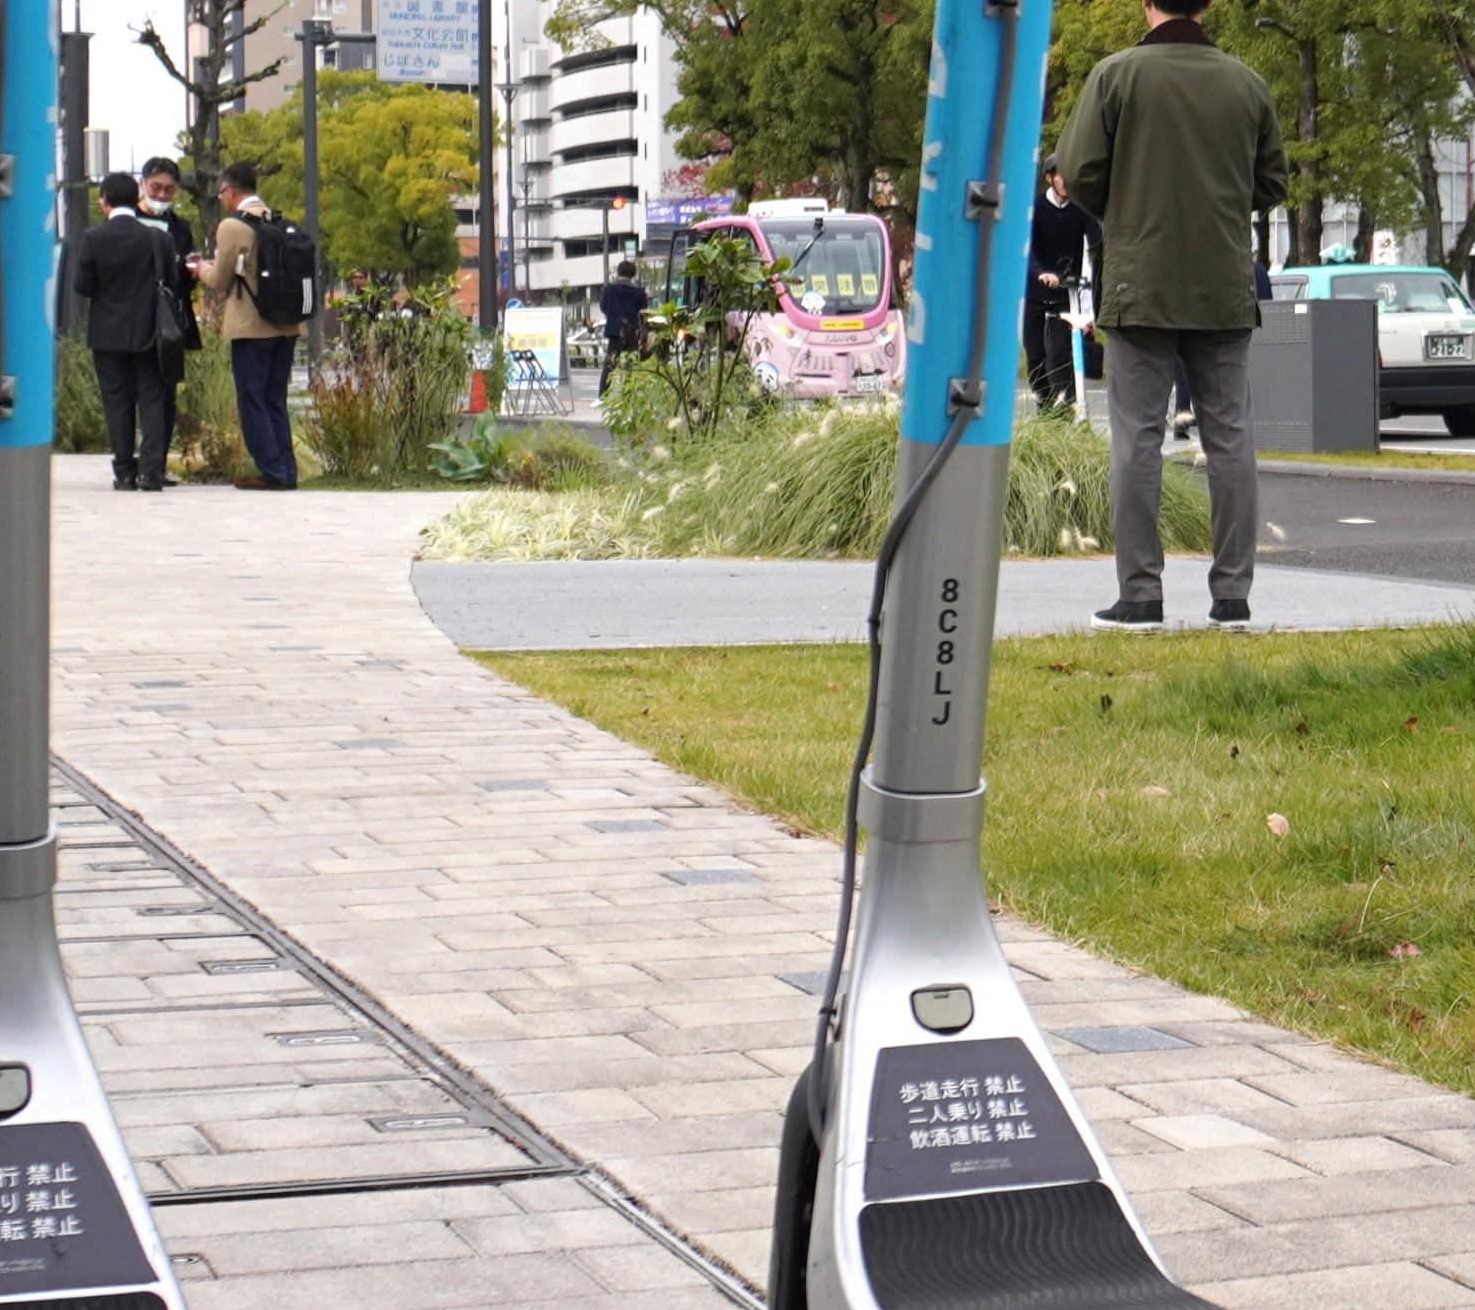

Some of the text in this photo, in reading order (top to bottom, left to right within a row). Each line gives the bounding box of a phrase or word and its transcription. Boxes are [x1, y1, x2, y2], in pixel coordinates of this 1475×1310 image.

[931, 578, 959, 727] 8C8LJ
[899, 1074, 1026, 1104] 歩道走行 禁止
[908, 1097, 1029, 1125] 二人乗り 禁止
[909, 1120, 1038, 1150] 飲酒運転 禁止
[26, 1161, 79, 1186] 禁止
[25, 1188, 79, 1213] 禁止
[31, 1214, 85, 1239] 禁止
